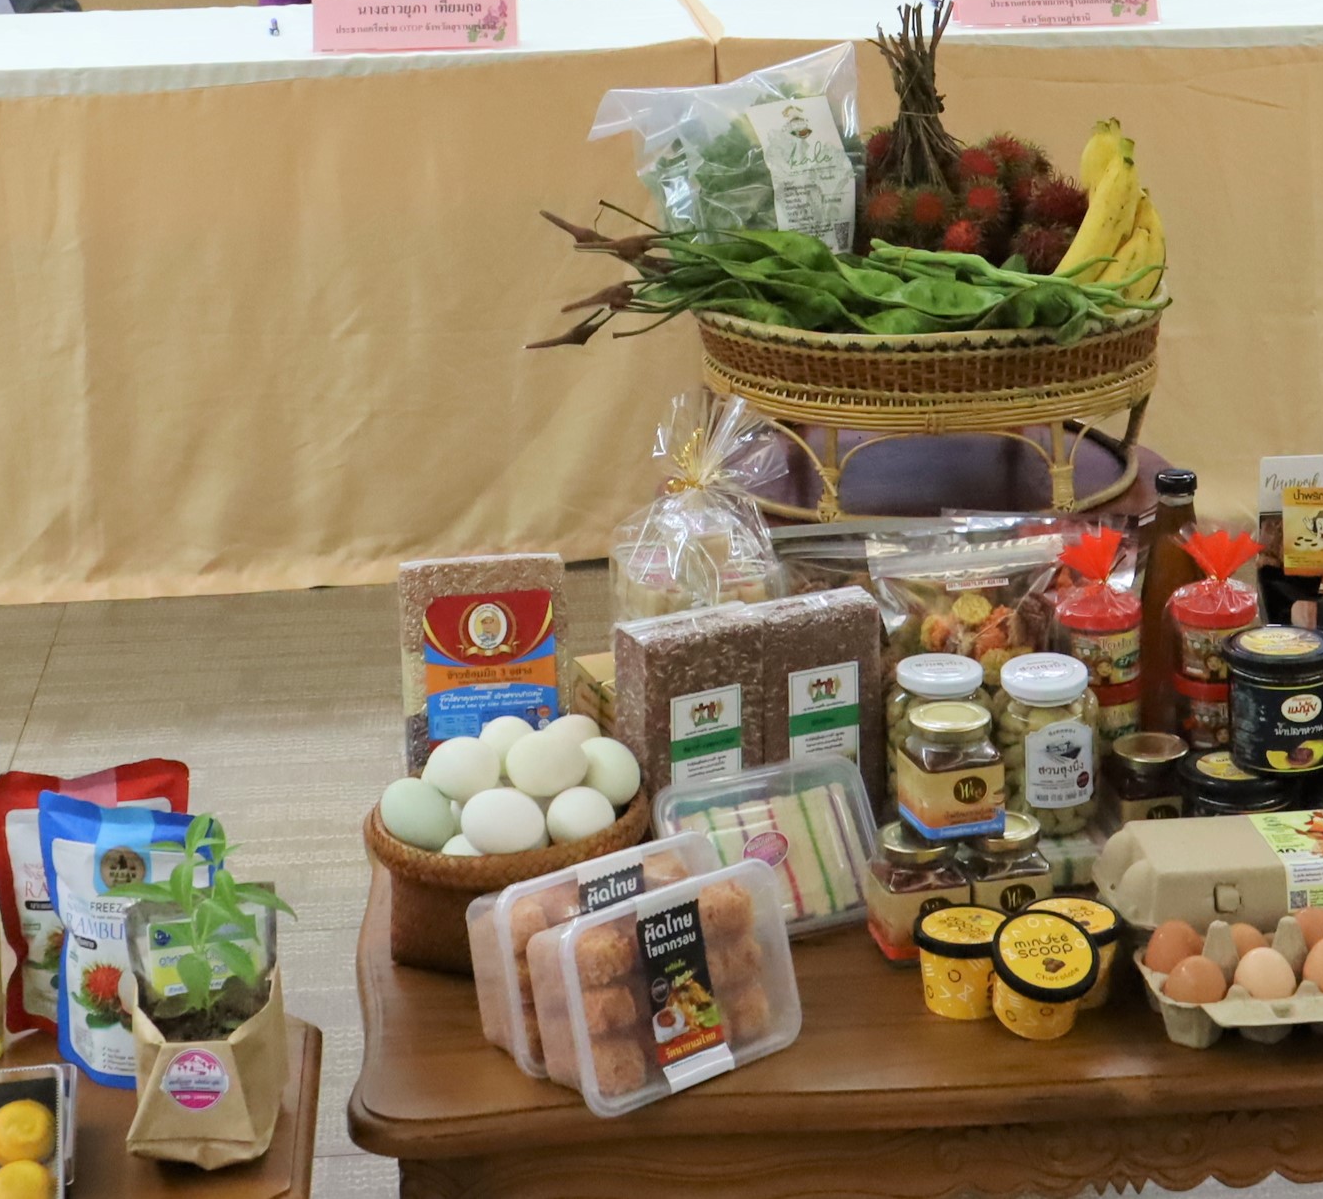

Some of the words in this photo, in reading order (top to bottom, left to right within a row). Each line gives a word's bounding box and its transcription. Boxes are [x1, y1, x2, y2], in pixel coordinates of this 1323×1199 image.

[399, 24, 424, 33] OTOP
[587, 875, 638, 908] ผัดไทย
[644, 911, 694, 944] ผัดไทย
[1014, 931, 1070, 950] minute
